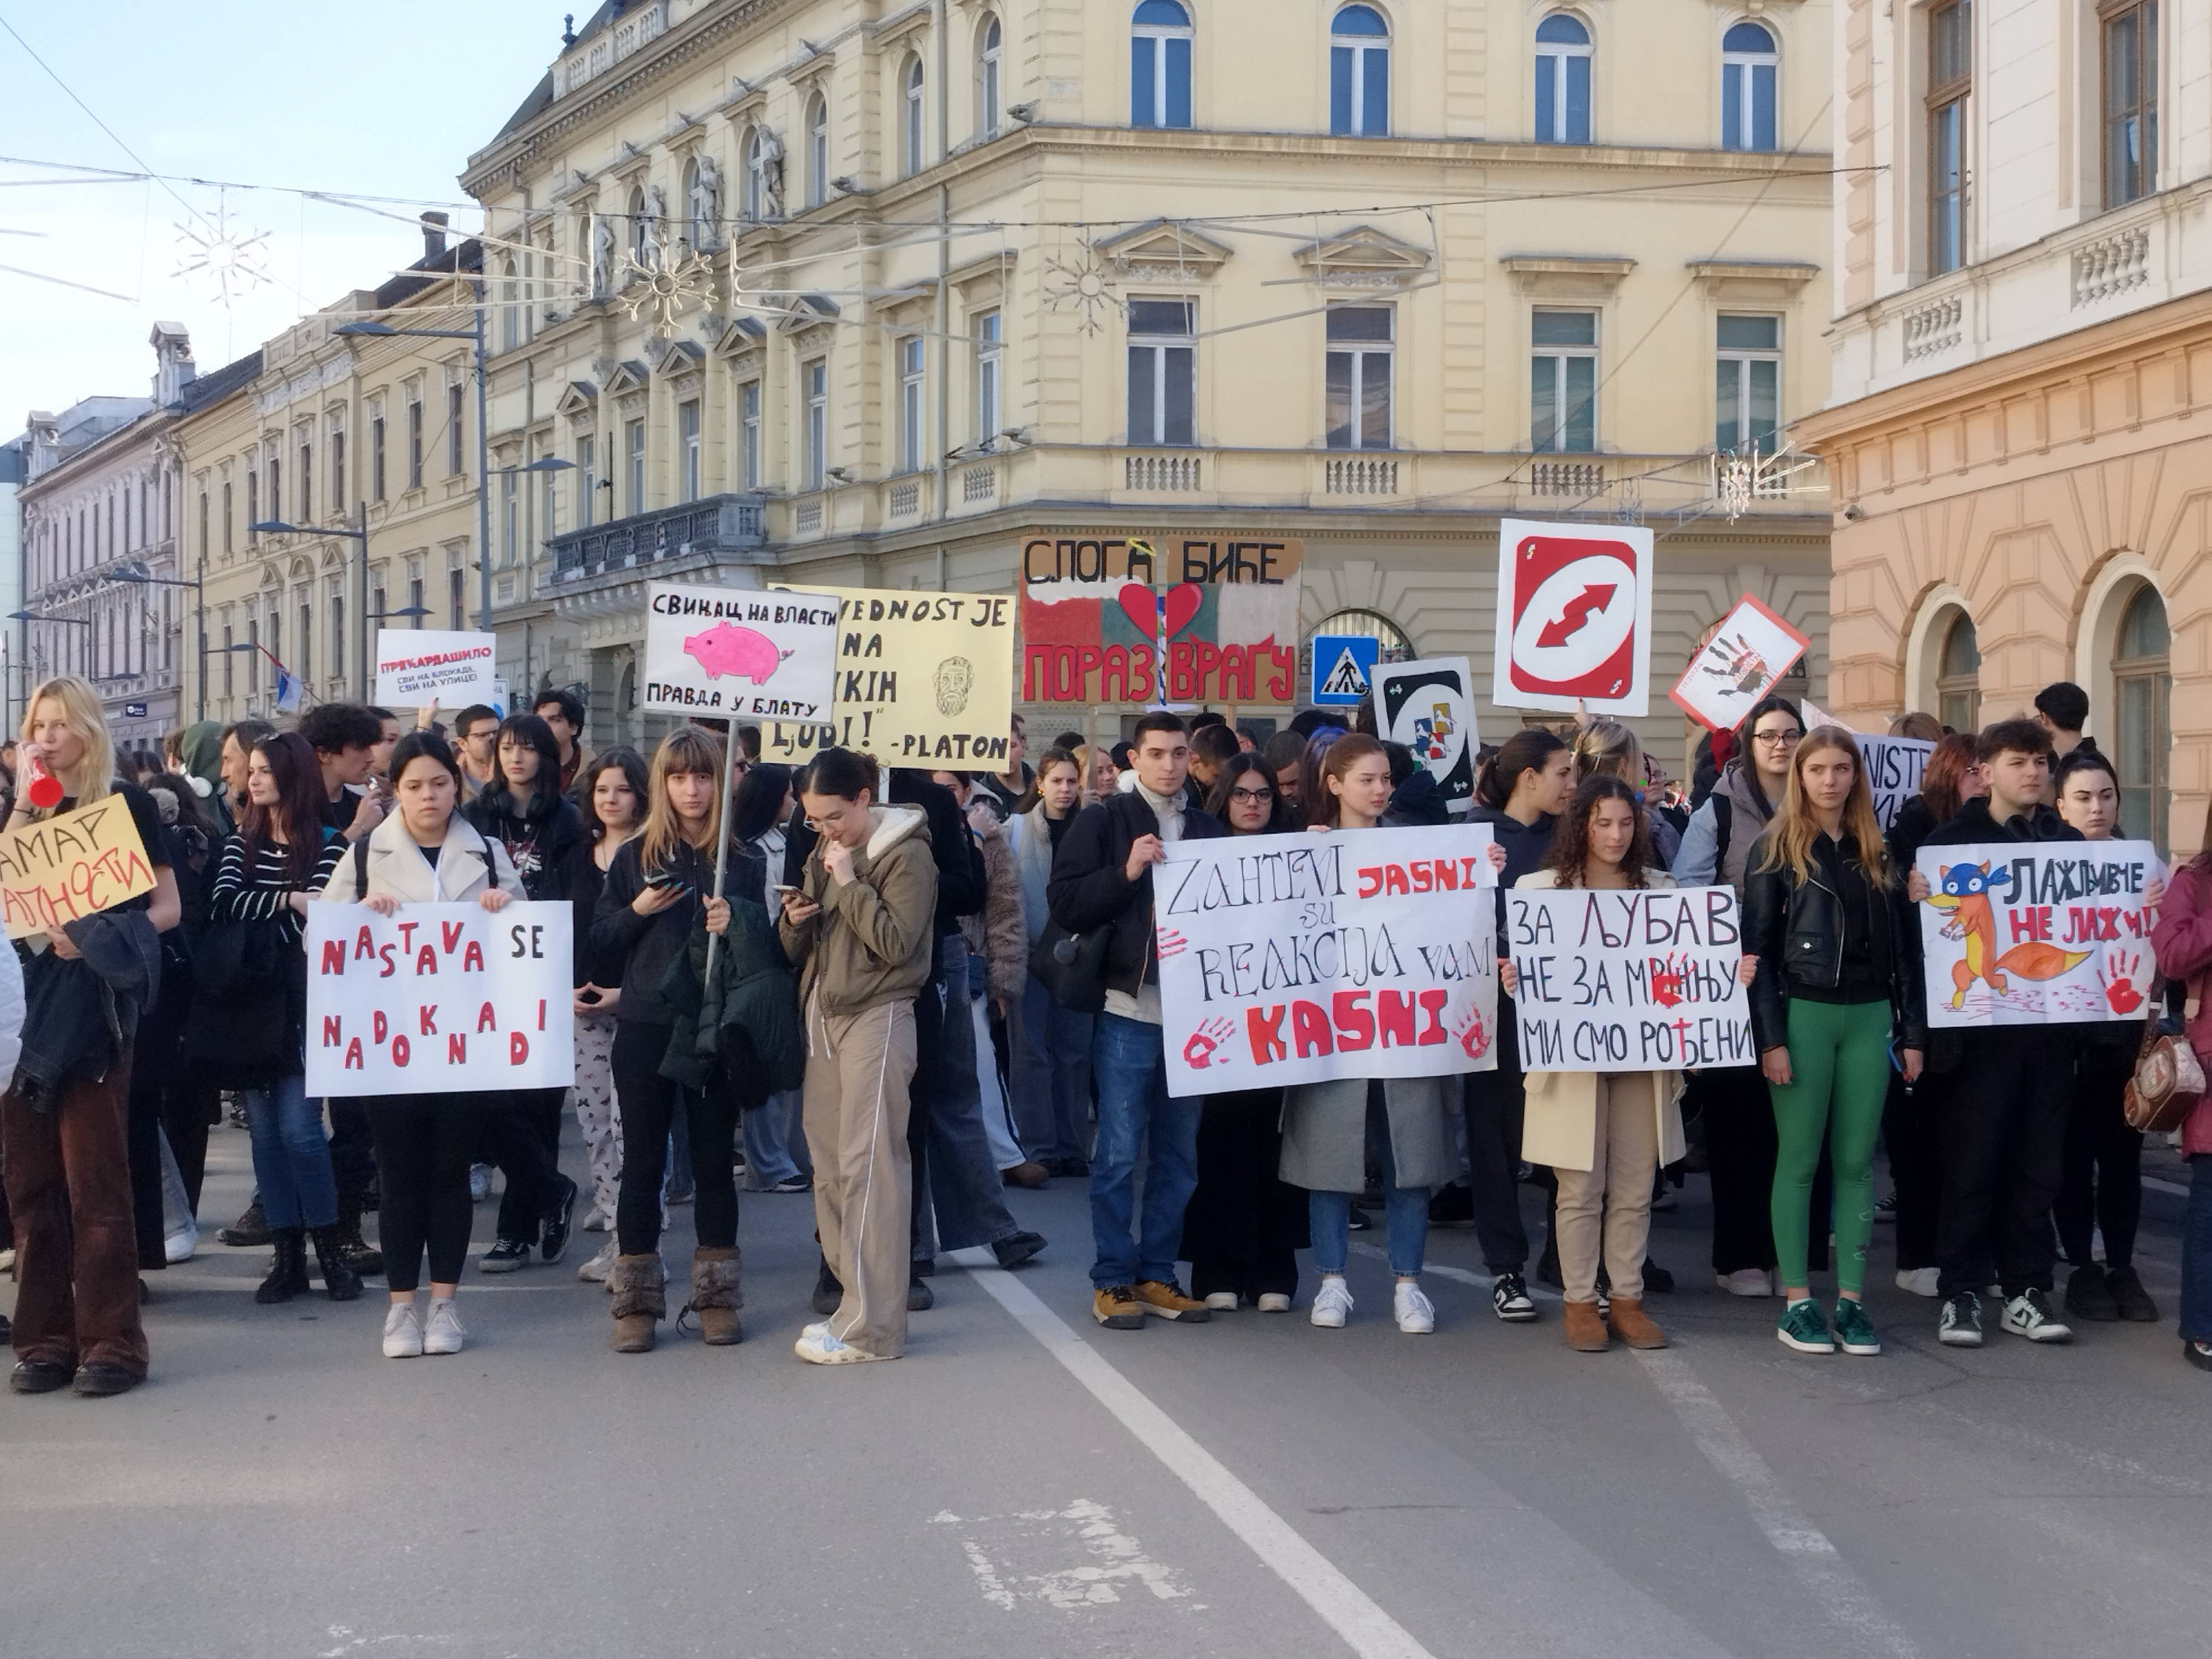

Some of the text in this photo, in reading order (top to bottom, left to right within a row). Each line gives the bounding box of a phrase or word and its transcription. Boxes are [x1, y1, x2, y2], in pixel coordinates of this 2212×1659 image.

[1025, 540, 1285, 585] СЛОГА БИЋЕ
[653, 594, 837, 627] СВИЊАЦ НА ВЛАСТИ
[970, 599, 1008, 627] JE
[843, 633, 882, 658] NA
[1024, 639, 1295, 702] ПОРАЗ ВРАГУ
[422, 680, 437, 689] НА
[646, 682, 819, 718] ПРАВДА У БЛАТУ
[1164, 845, 1477, 915] ZAHTEVI JASNI
[1513, 891, 1739, 948] ЗА ЉУБАВ
[2008, 906, 2053, 943] НЕ
[321, 921, 544, 978] NASTAVA SE
[1194, 923, 1406, 1001] REAKCIJA
[1516, 956, 1563, 1005] НЕ
[1573, 956, 1614, 1008] ЗА
[324, 999, 547, 1070] NADOKNADI
[1245, 989, 1448, 1066] KASNI
[1523, 1017, 1755, 1068] МИ СМО РОЂЕНИ
